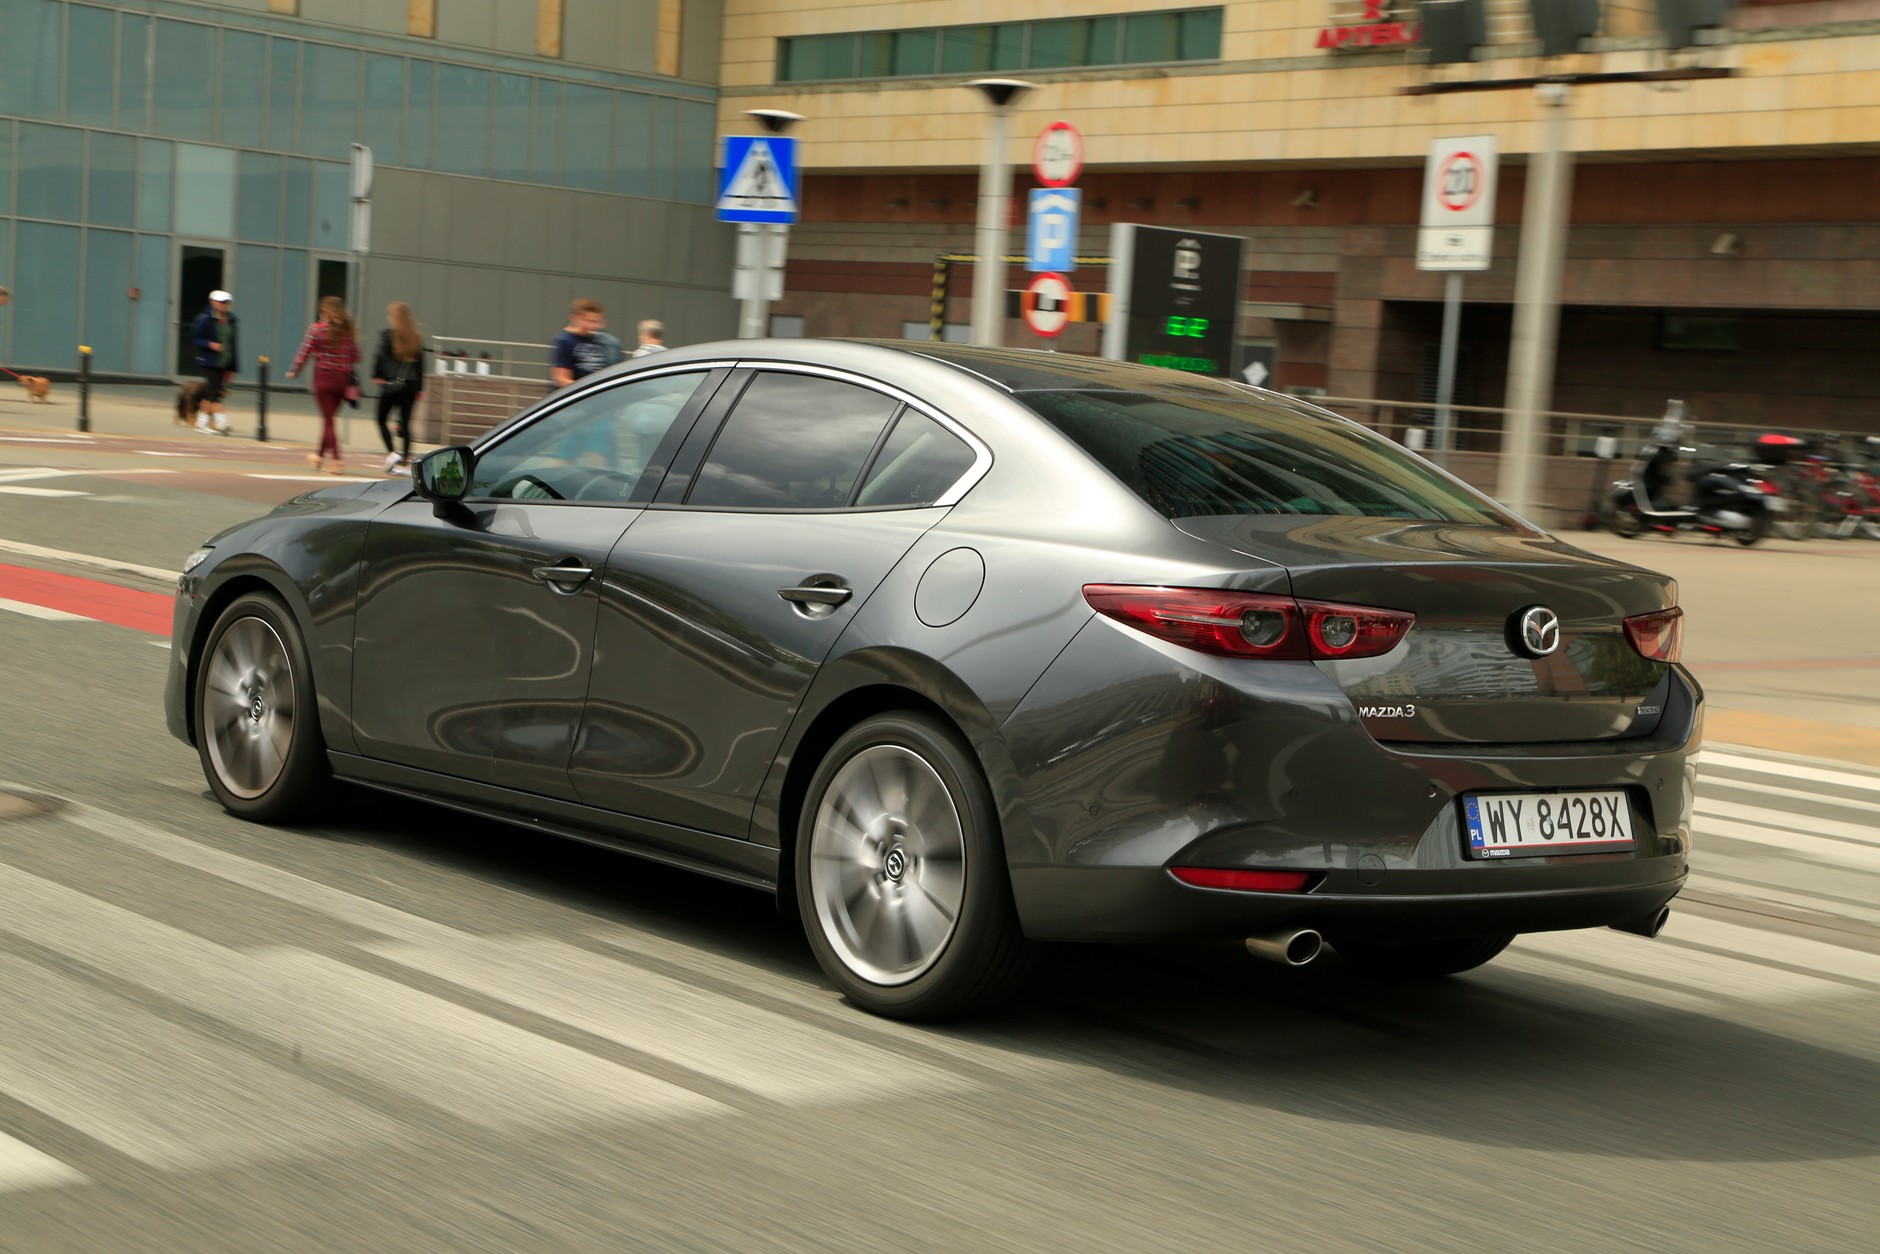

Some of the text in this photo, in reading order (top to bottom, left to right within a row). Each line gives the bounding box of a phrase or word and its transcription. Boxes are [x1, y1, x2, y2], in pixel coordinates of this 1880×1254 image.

[1035, 214, 1070, 262] P
[1470, 829, 1483, 841] PL
[1486, 796, 1625, 844] WY 8428X
